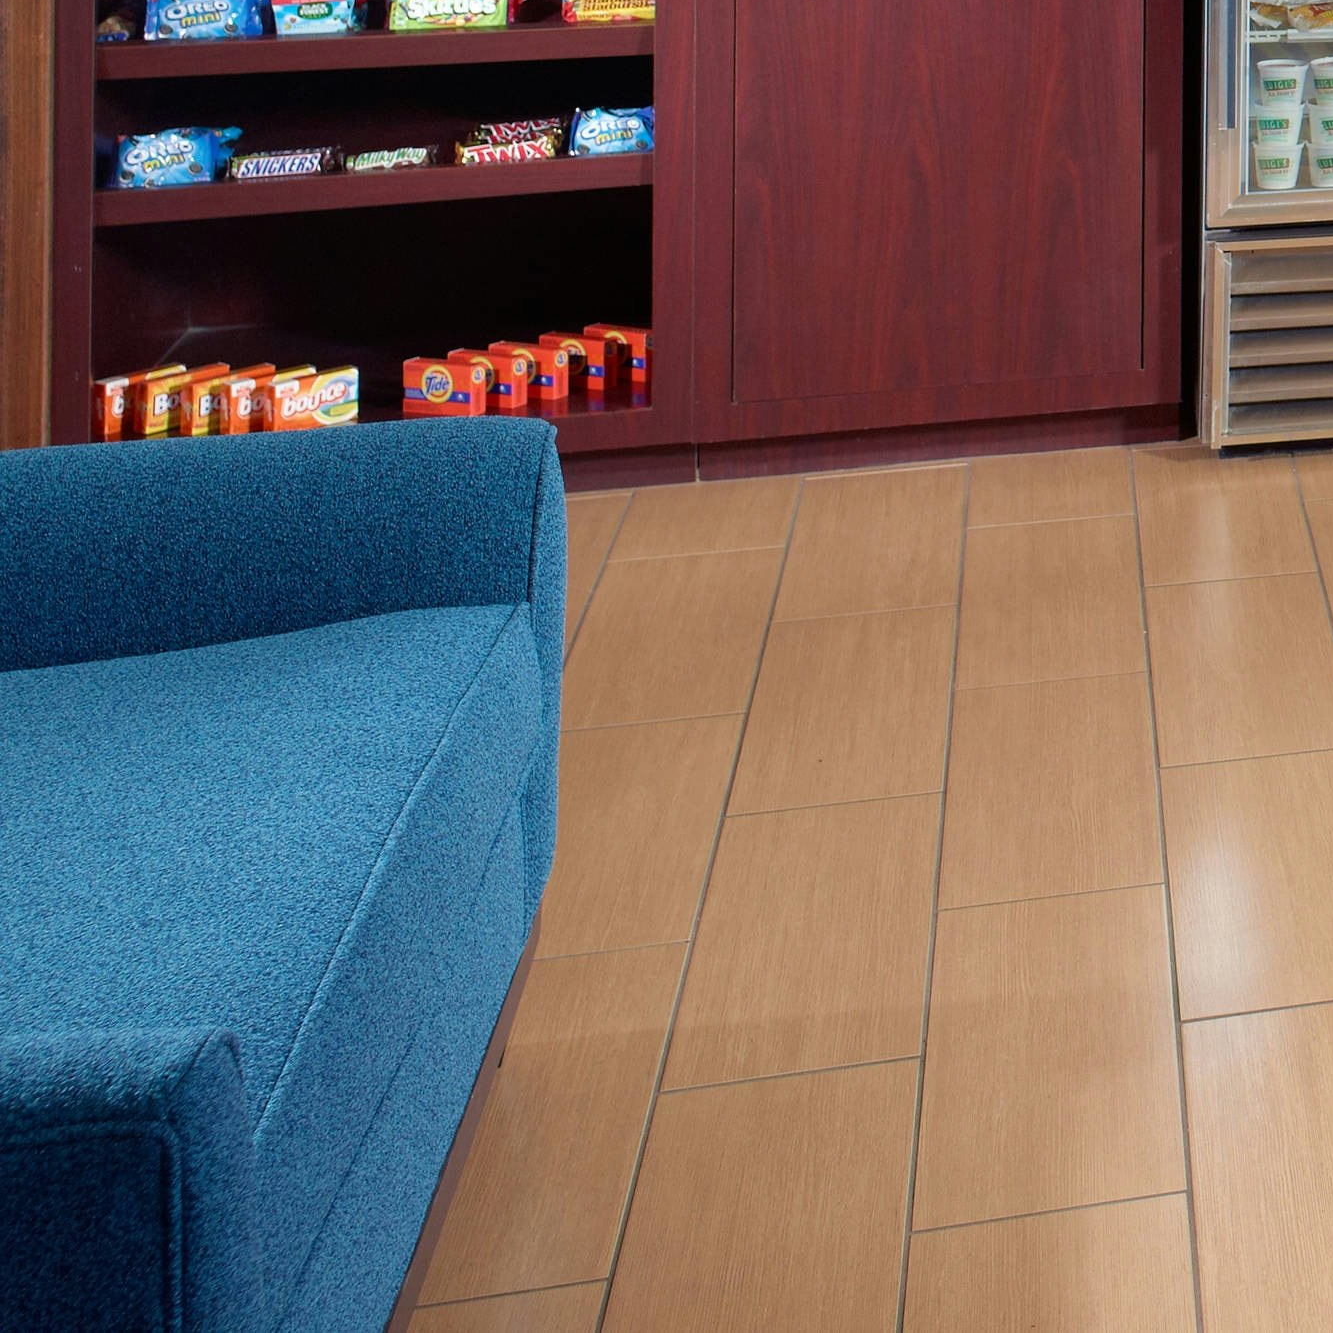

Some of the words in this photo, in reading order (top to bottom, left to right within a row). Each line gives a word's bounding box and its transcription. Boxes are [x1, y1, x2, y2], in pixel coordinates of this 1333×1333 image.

[166, 0, 230, 21] OREO
[181, 13, 221, 29] mini
[581, 118, 641, 141] OREO
[126, 138, 193, 165] OREO
[240, 154, 321, 178] SNICKERS
[425, 374, 450, 394] Tide
[283, 383, 348, 417] bounce
